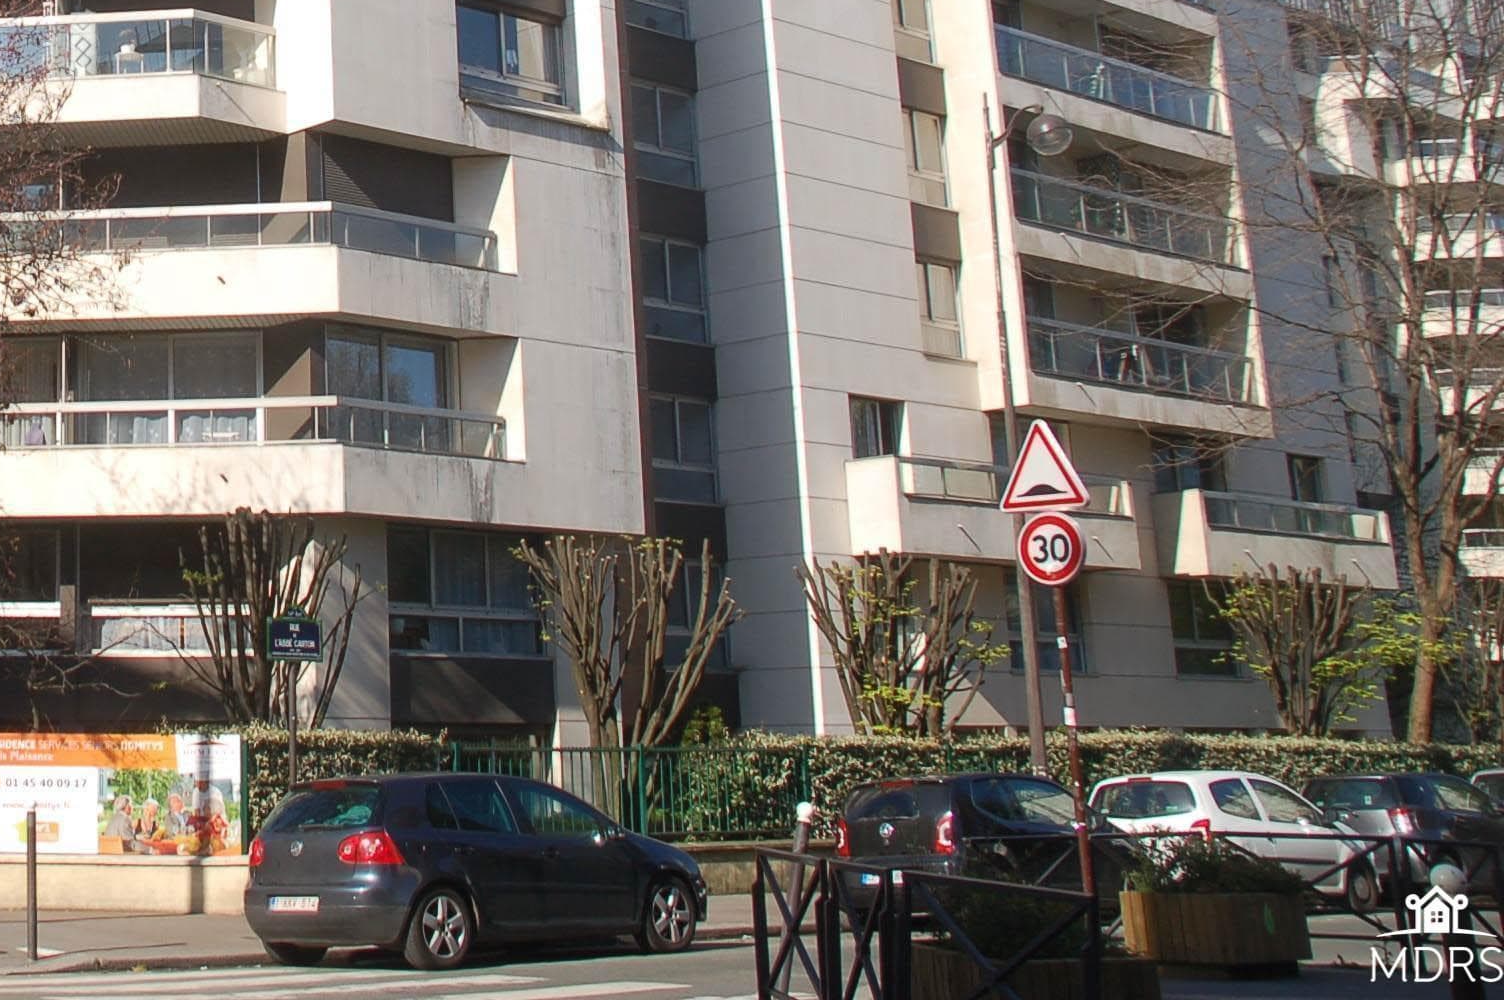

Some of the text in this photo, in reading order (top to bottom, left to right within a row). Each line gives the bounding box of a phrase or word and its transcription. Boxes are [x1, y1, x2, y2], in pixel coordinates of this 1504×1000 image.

[1032, 533, 1070, 563] 30
[10, 751, 55, 761] Plaisance
[5, 778, 87, 788] 01 45 40 09 17
